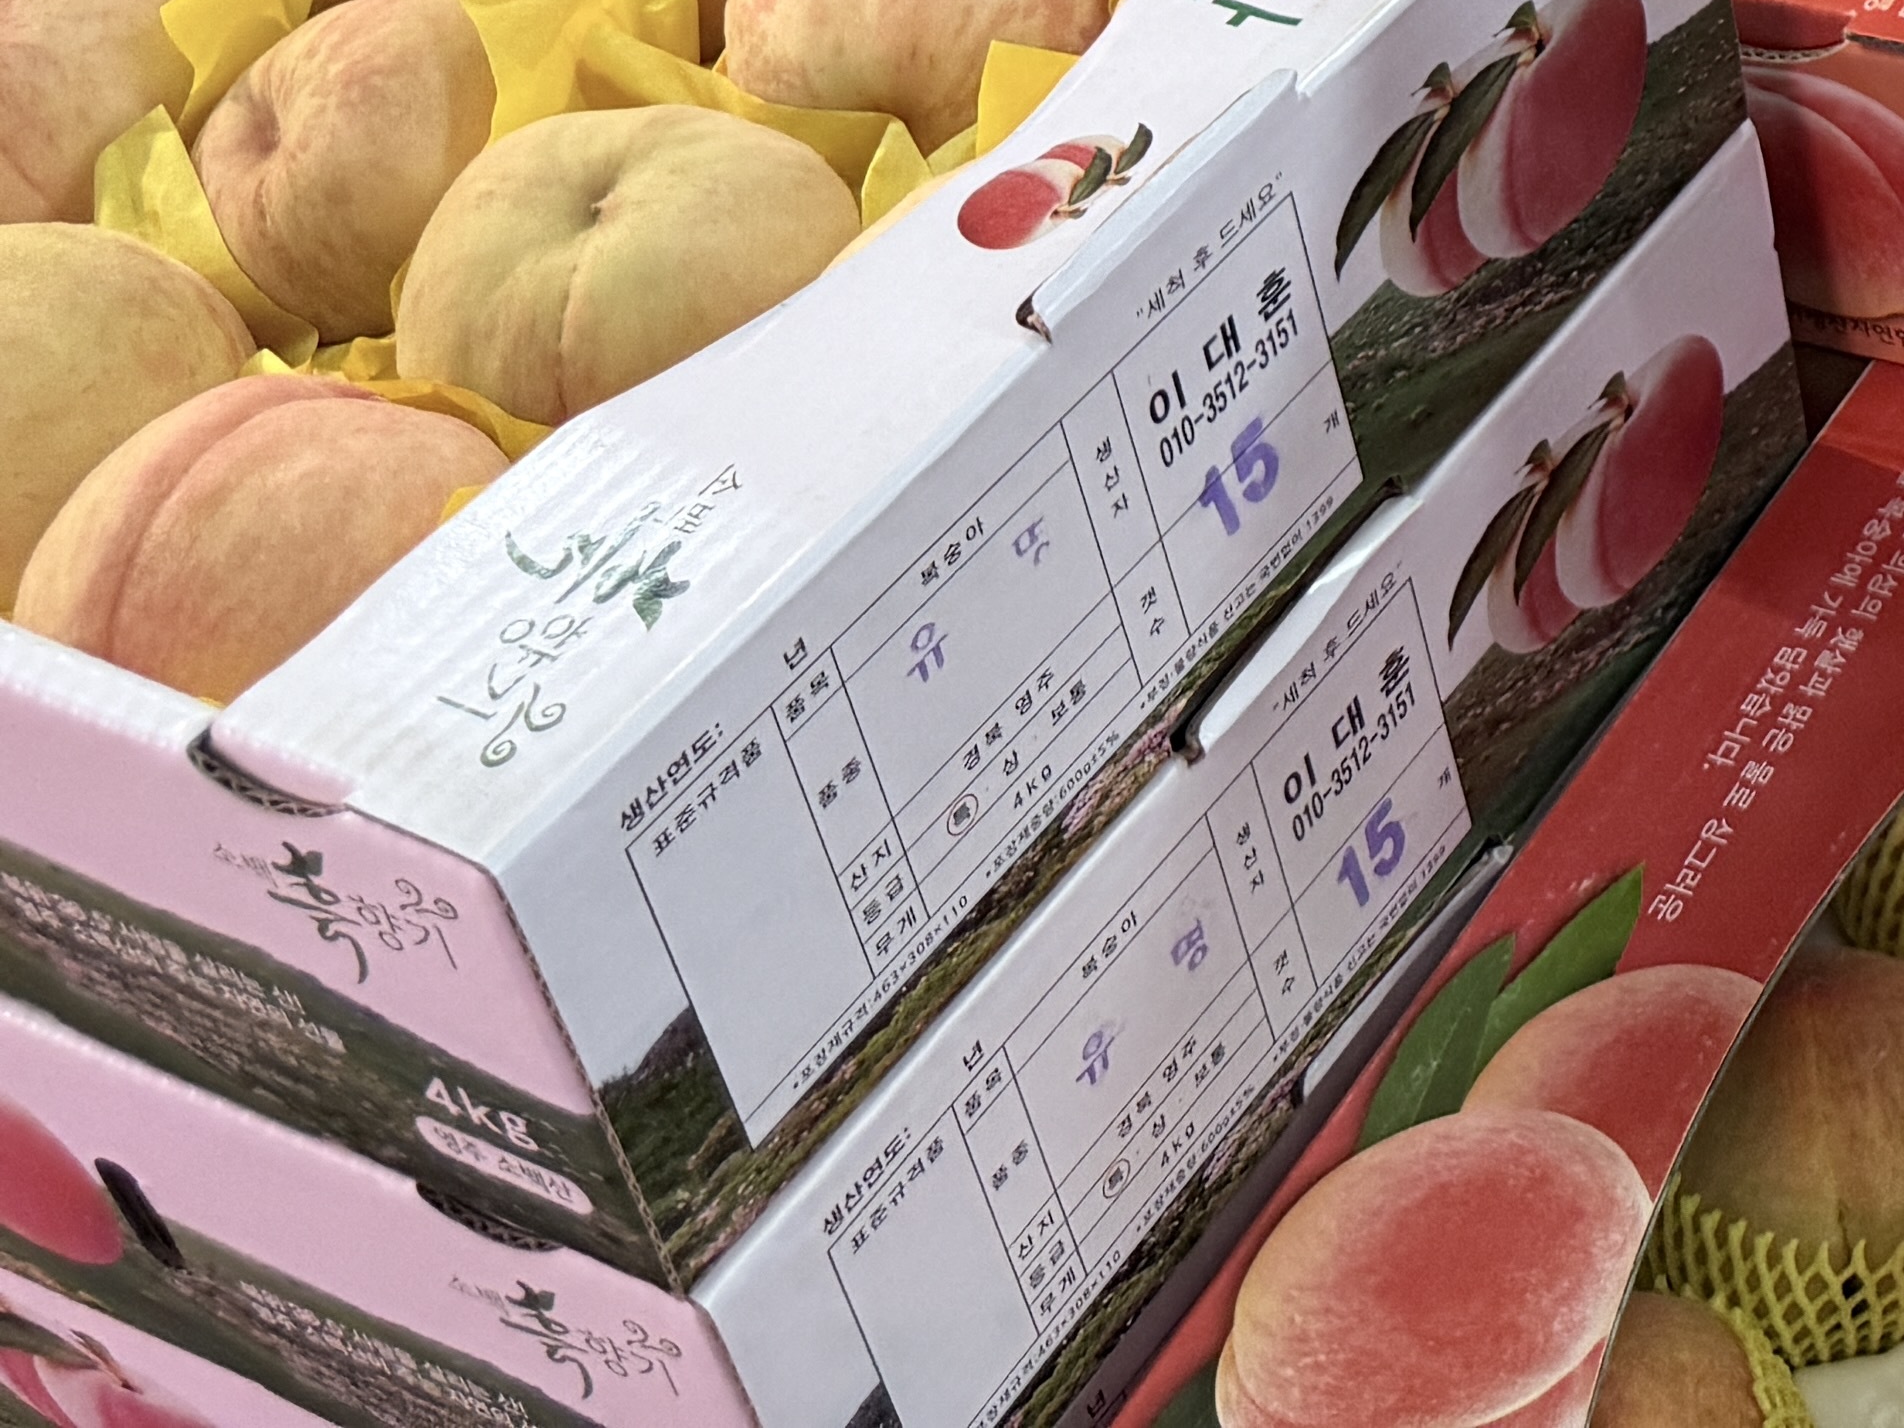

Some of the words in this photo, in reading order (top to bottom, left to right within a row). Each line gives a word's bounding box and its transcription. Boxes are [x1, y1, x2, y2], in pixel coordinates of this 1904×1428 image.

[1192, 243, 1214, 270] 후
[1159, 310, 1301, 470] 010-3512-3151
[1094, 437, 1129, 517] 생산자
[1200, 416, 1281, 536] 15
[920, 517, 987, 586] 복숭아
[1140, 588, 1165, 637] 갯수
[1795, 592, 1843, 639] 가득
[784, 671, 831, 721] 품목
[1799, 627, 1864, 697] 햇살과
[620, 721, 725, 830] 생산연도:
[781, 637, 810, 667] 년
[1050, 679, 1089, 721] 보통
[1762, 706, 1812, 754] 맑은
[817, 757, 862, 809] 품종
[848, 841, 892, 894] 산지
[962, 721, 1003, 771] 경북
[1013, 667, 1057, 716] 영주
[1293, 683, 1416, 842] 010-3512-3151
[1723, 760, 1775, 809] 물로
[653, 739, 763, 859] 표준규격품
[1338, 799, 1407, 906] 15
[1648, 817, 1734, 921] 싱그러운
[874, 909, 918, 957] 무게
[1080, 910, 1140, 978] 복숭아
[425, 1077, 541, 1151] 4kg
[496, 1154, 573, 1203] 소백산
[822, 1128, 911, 1235] 생산연도:
[852, 1136, 945, 1254] 표준규격품
